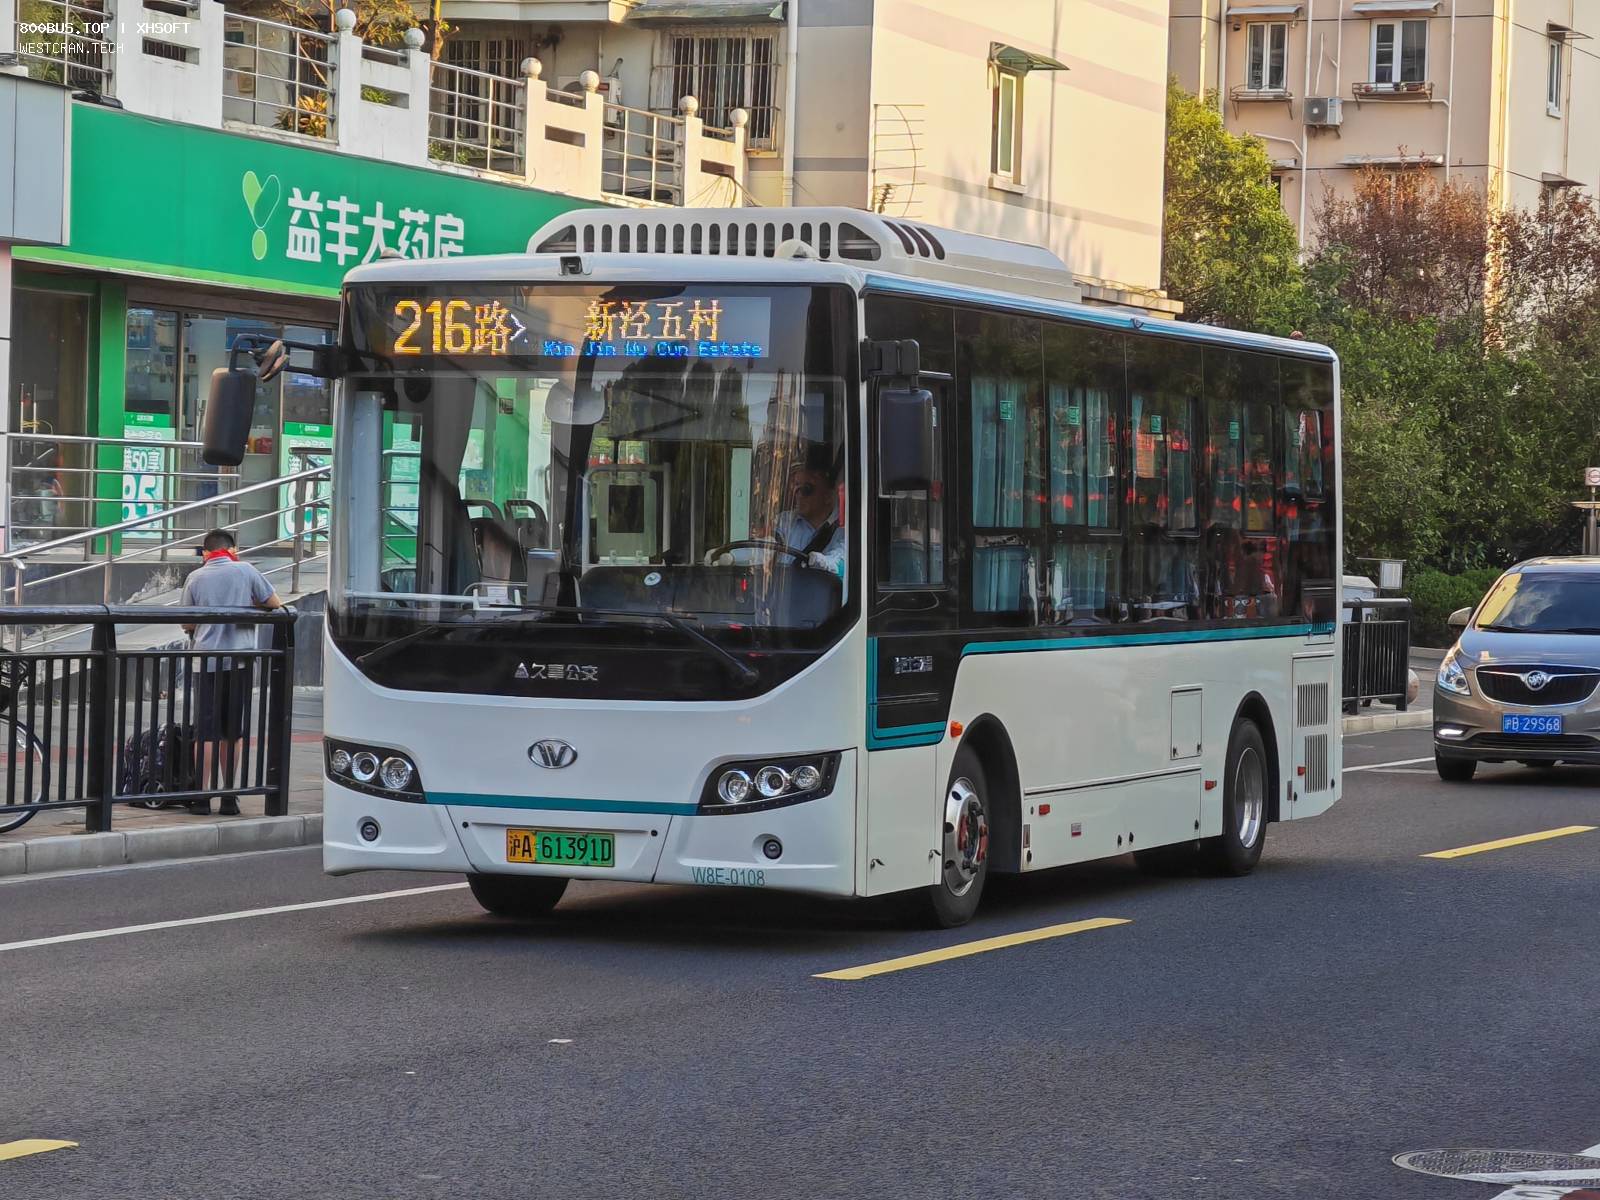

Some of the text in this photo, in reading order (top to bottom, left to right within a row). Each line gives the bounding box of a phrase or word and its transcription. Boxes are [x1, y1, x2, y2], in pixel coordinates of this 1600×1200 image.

[286, 187, 464, 265] 益丰大药房
[394, 300, 512, 355] 216路
[584, 300, 723, 341] 新泾五村
[698, 341, 763, 356] Estate
[531, 662, 598, 681] 久事公交
[692, 866, 765, 886] W8E-0108
